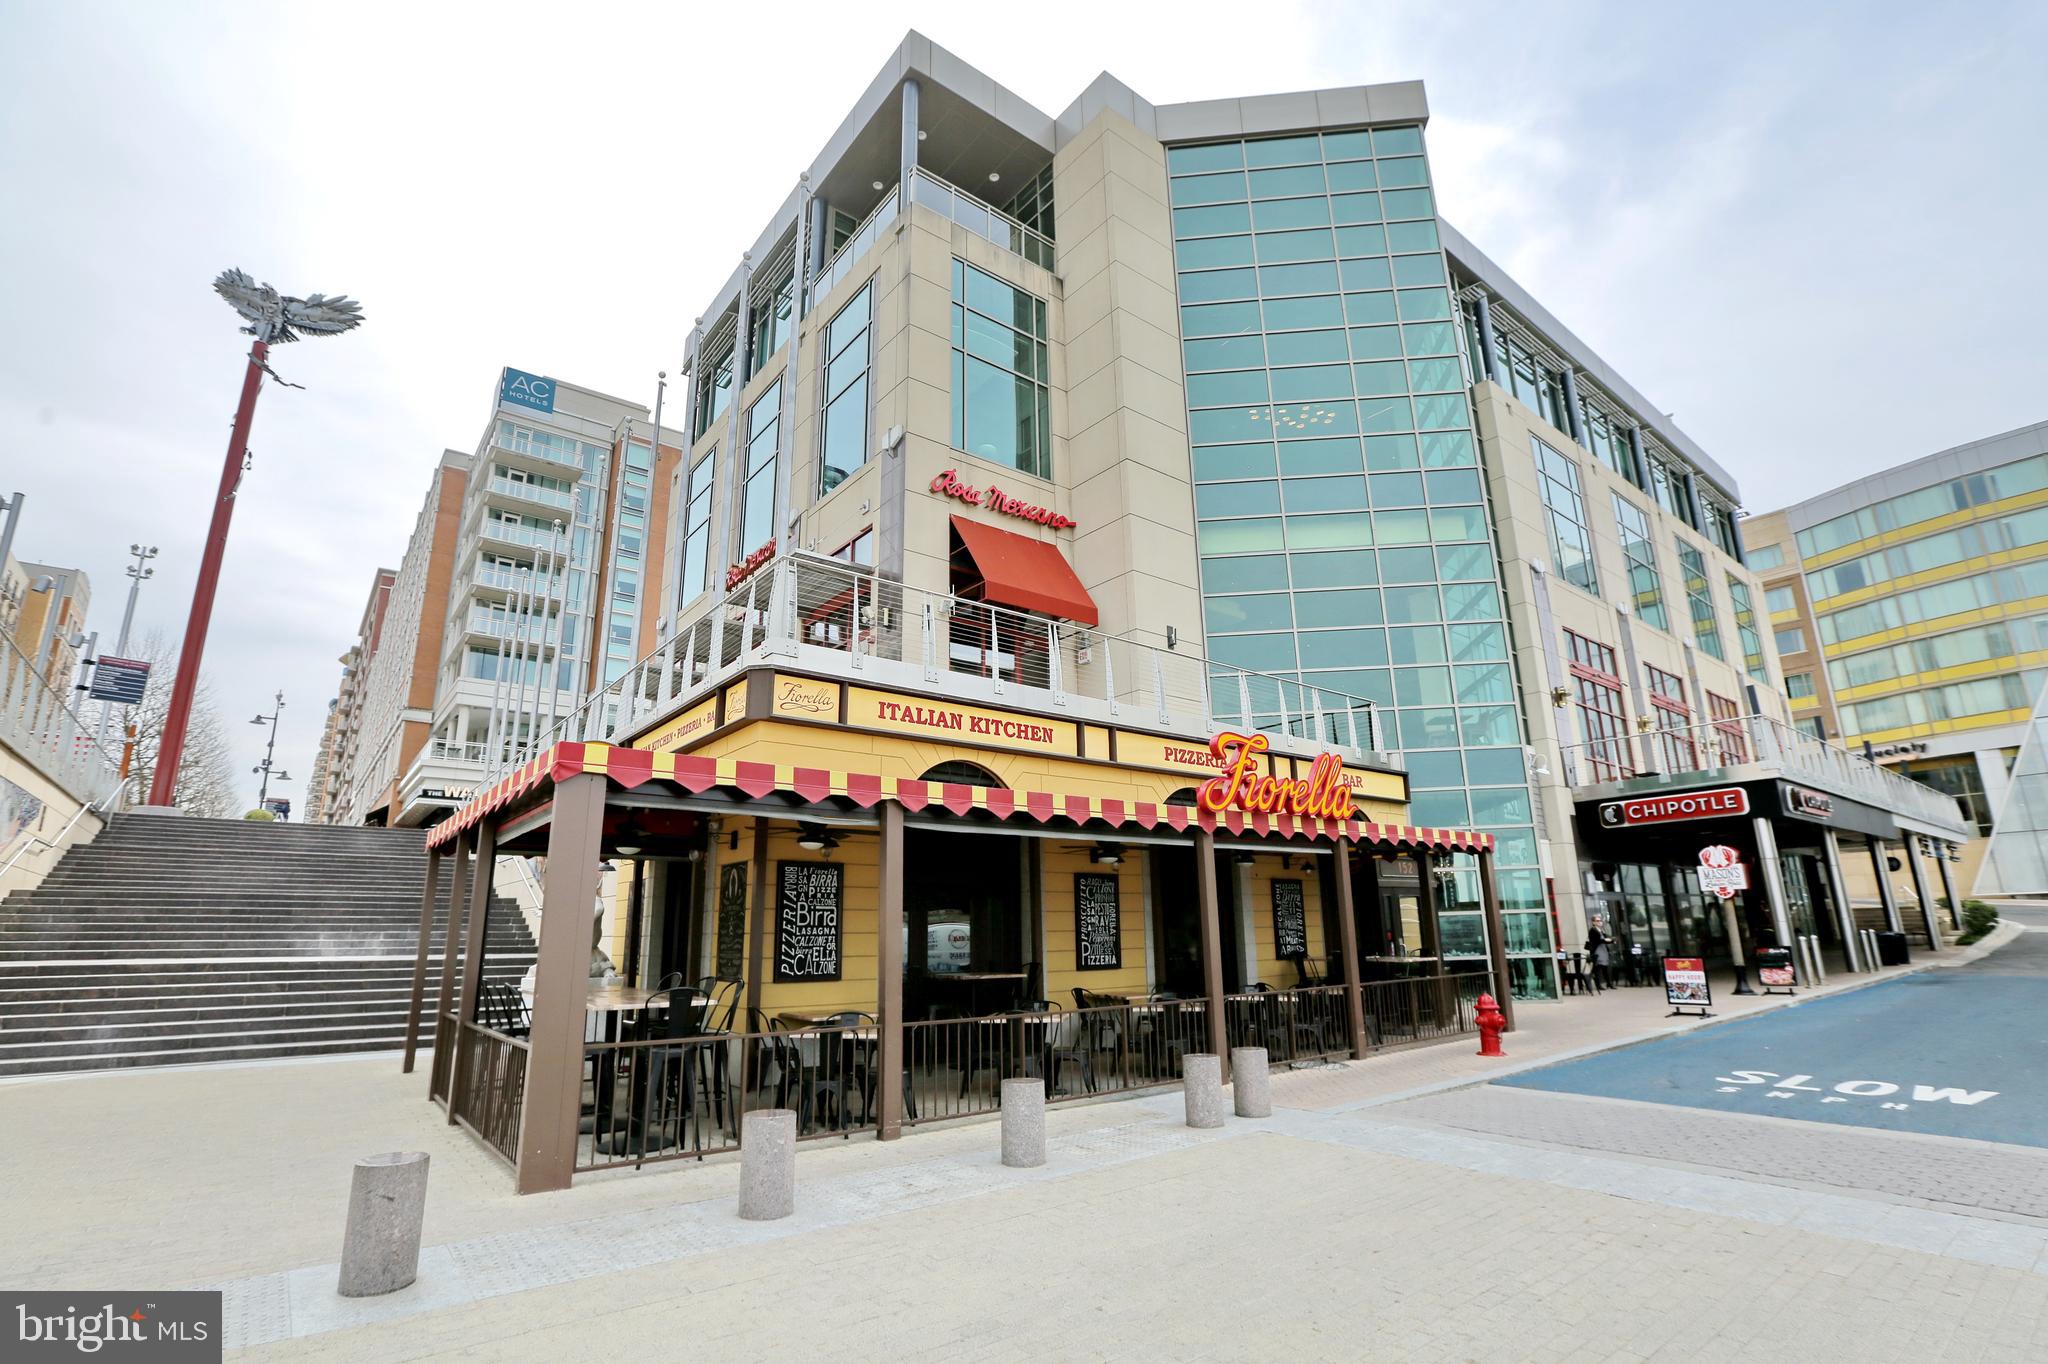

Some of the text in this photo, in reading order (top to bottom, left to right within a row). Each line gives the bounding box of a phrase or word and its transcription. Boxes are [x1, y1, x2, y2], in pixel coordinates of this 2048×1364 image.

[510, 390, 548, 407] HOTELS
[511, 376, 549, 398] AC
[929, 468, 1076, 529] Rosa Mexicano
[778, 682, 834, 711] Fiorella
[677, 717, 702, 739] PIZZERIA
[707, 710, 716, 724] BA
[878, 701, 1054, 744] ITALIAN KITCHEN
[1163, 746, 1363, 788] PIZZERIA BAR
[1197, 731, 1360, 820] Fiorella
[1628, 794, 1738, 819] CHIPOTLE
[809, 874, 838, 887] BIRRA
[1398, 862, 1413, 874] 152
[797, 901, 837, 926] Birra
[781, 890, 797, 976] PIZZERIA
[795, 936, 828, 947] CALZONE
[796, 927, 836, 935] LASAGNA
[1715, 1070, 2000, 1105] SLOW
